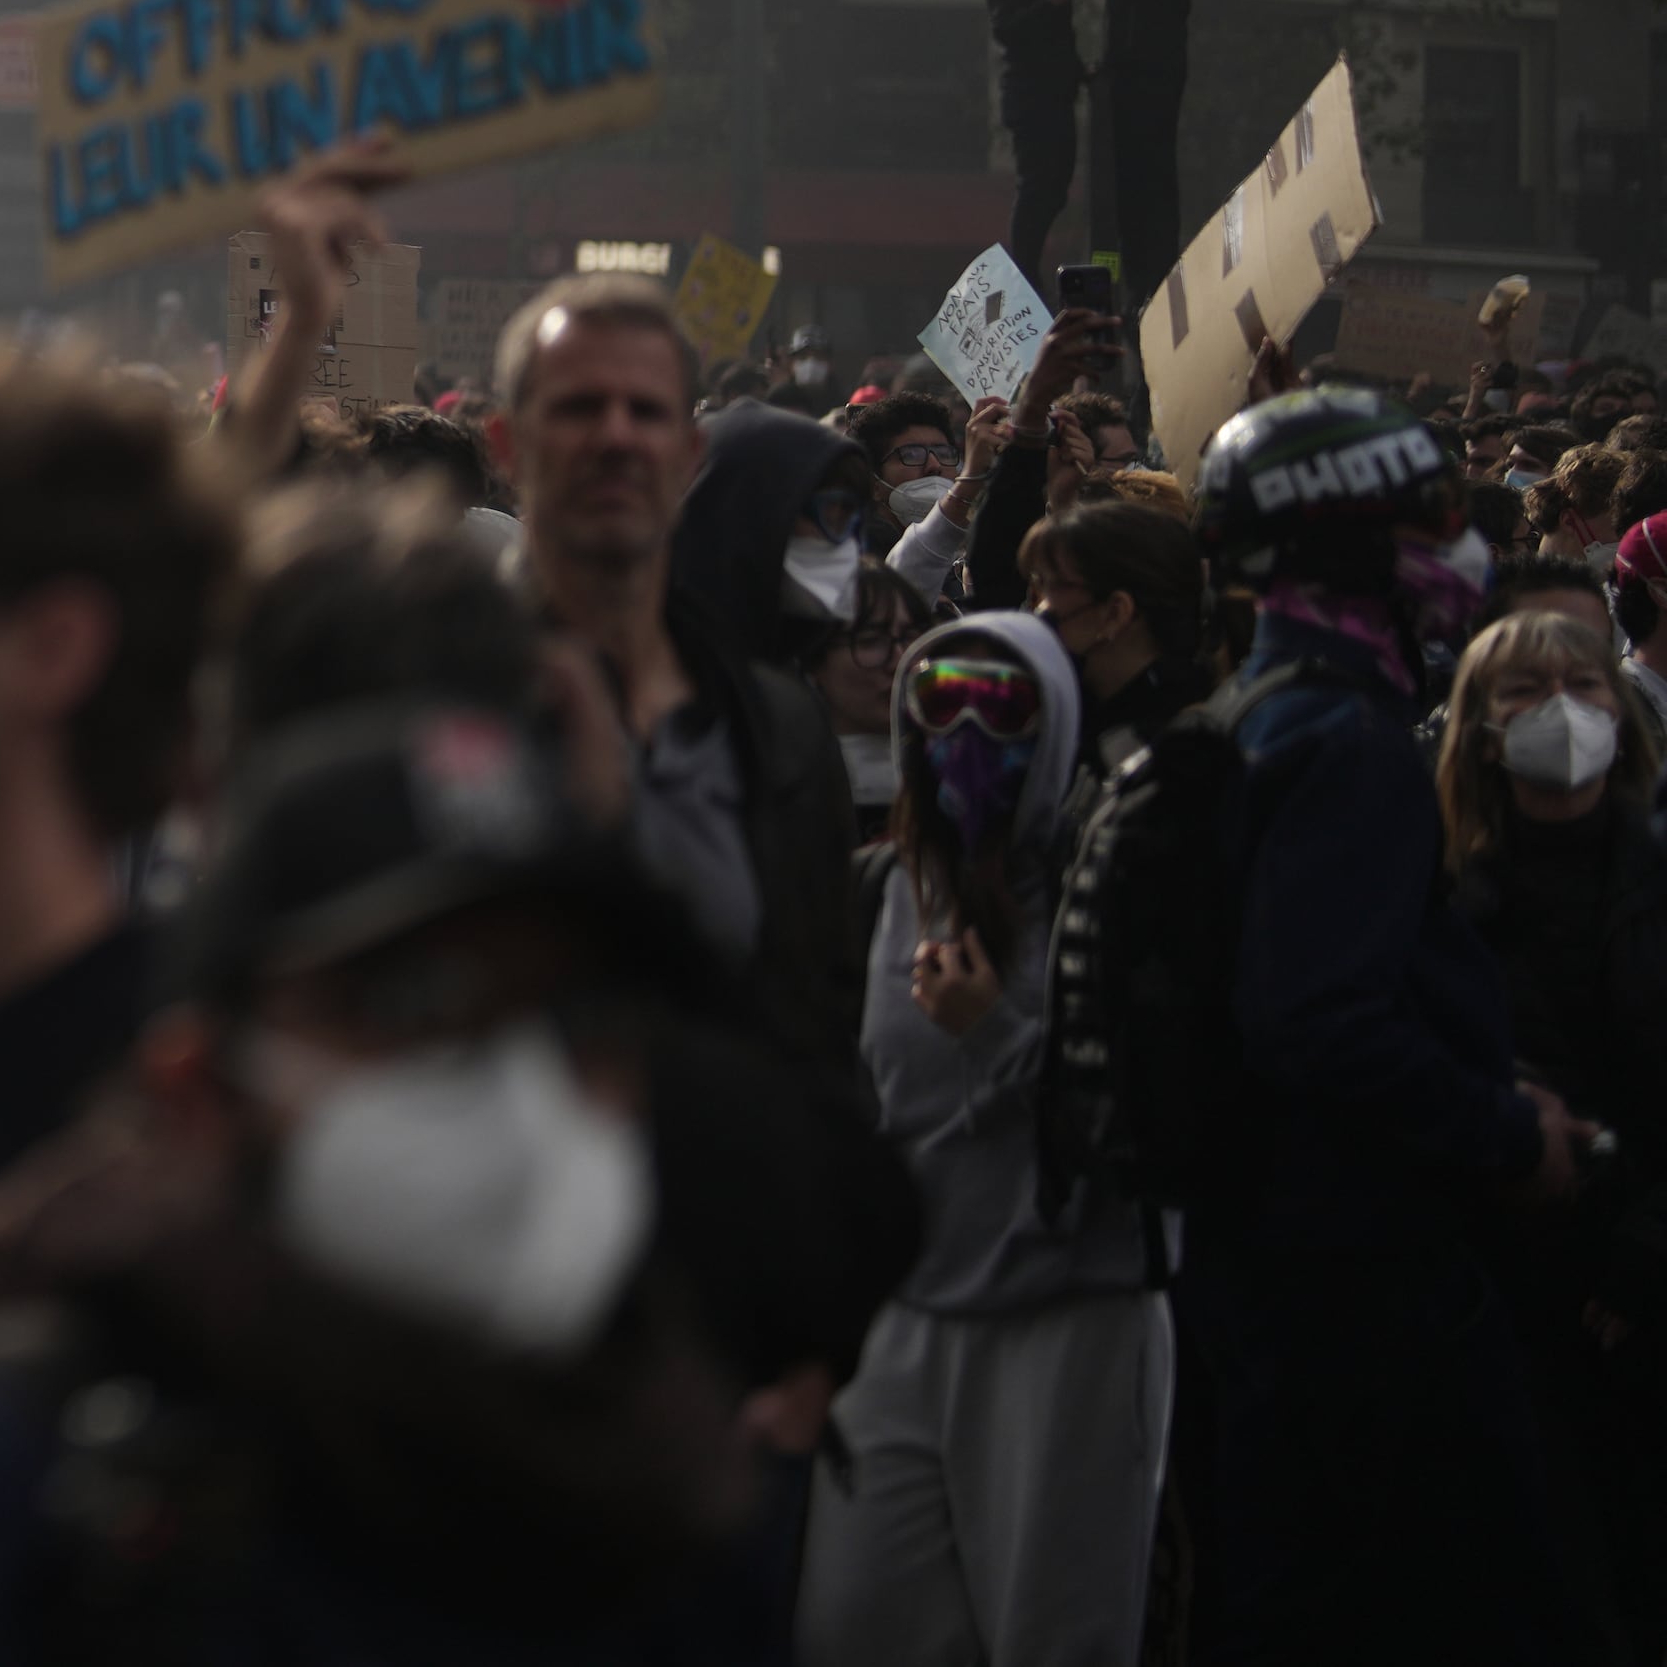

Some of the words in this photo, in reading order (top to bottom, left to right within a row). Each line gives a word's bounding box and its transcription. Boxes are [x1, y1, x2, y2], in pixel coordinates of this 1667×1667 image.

[49, 97, 227, 239] LEUR
[231, 58, 342, 181] UN
[938, 288, 963, 333] NON
[980, 322, 1038, 396] RACISTES
